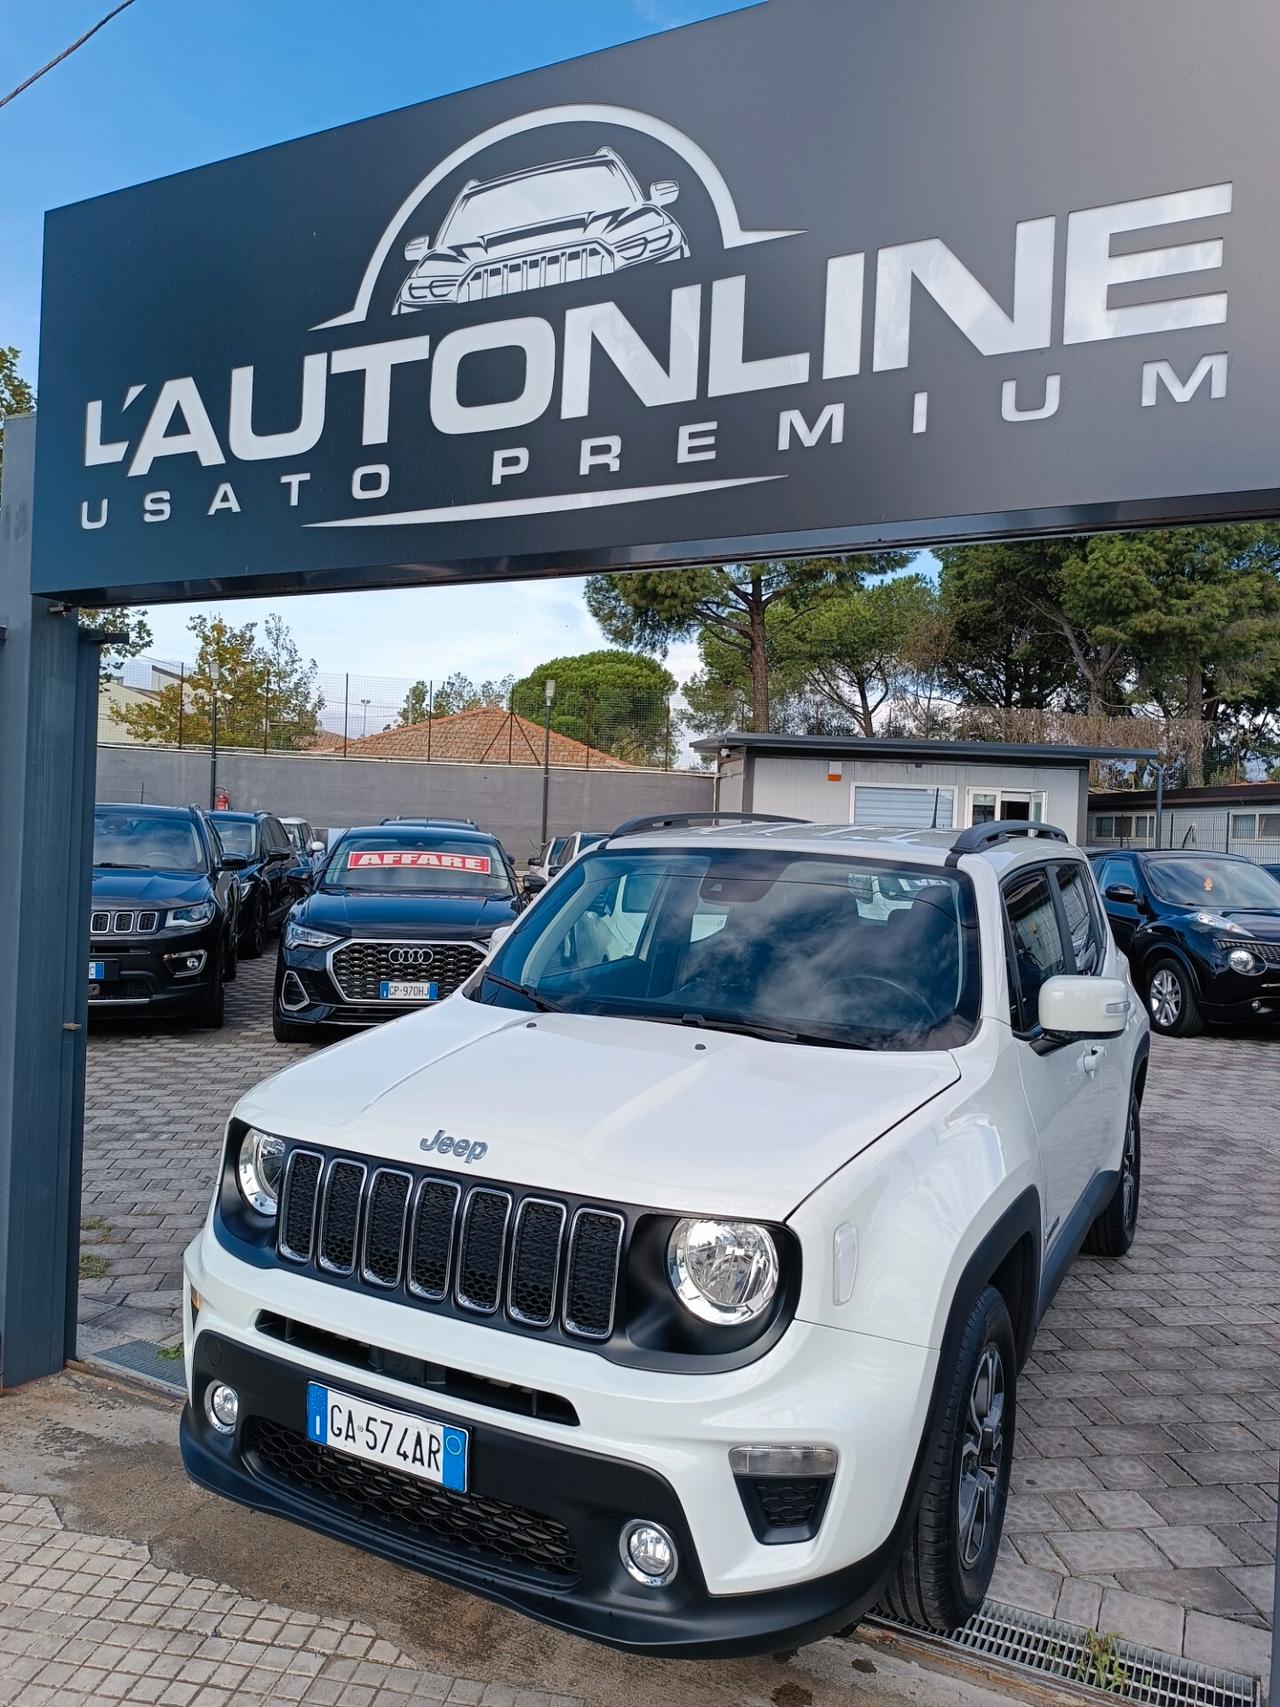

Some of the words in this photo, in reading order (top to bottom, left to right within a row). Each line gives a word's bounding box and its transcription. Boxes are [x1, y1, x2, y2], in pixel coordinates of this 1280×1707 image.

[80, 463, 391, 530] USATO
[491, 351, 1229, 486] PREMIUM
[358, 854, 482, 870] AFFARE
[419, 1129, 489, 1165] Jeep
